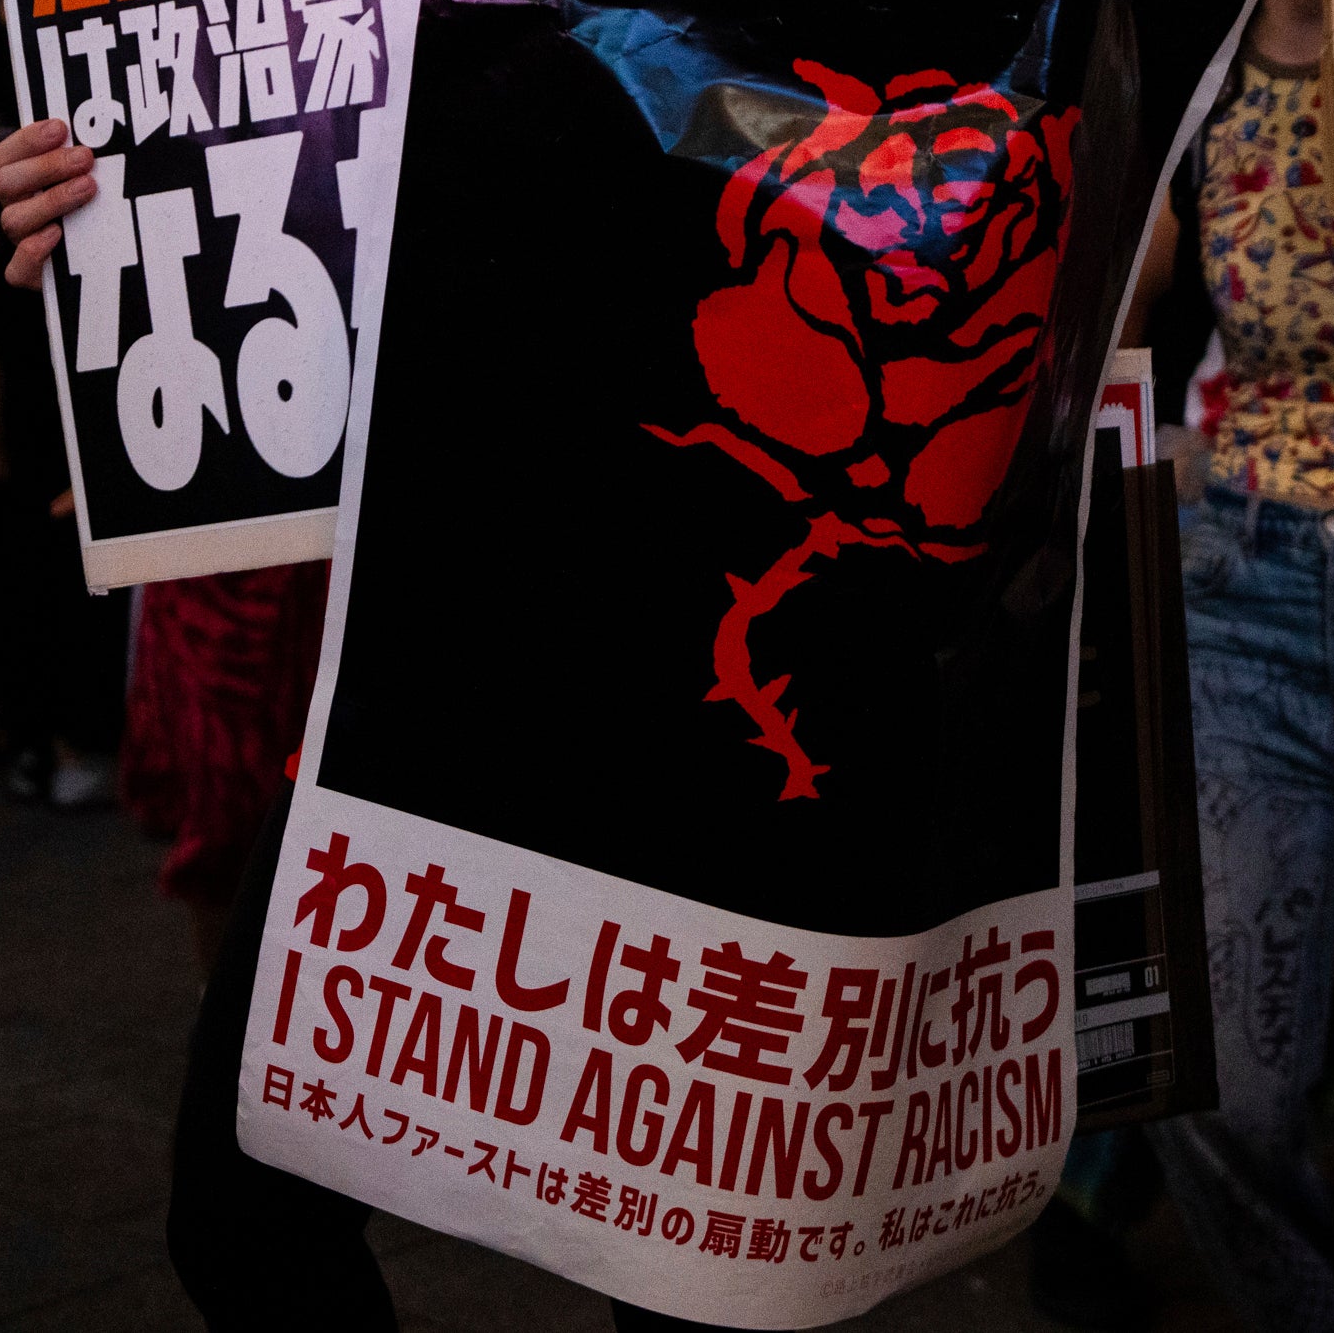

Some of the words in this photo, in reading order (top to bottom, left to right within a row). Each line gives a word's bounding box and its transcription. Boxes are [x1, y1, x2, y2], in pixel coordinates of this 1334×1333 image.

[272, 949, 304, 1046] I
[312, 963, 552, 1127] STAND
[559, 1048, 895, 1201] AGAINST
[893, 1050, 1062, 1191] RACISM
[293, 831, 1061, 1093] わたしは差別に抗う
